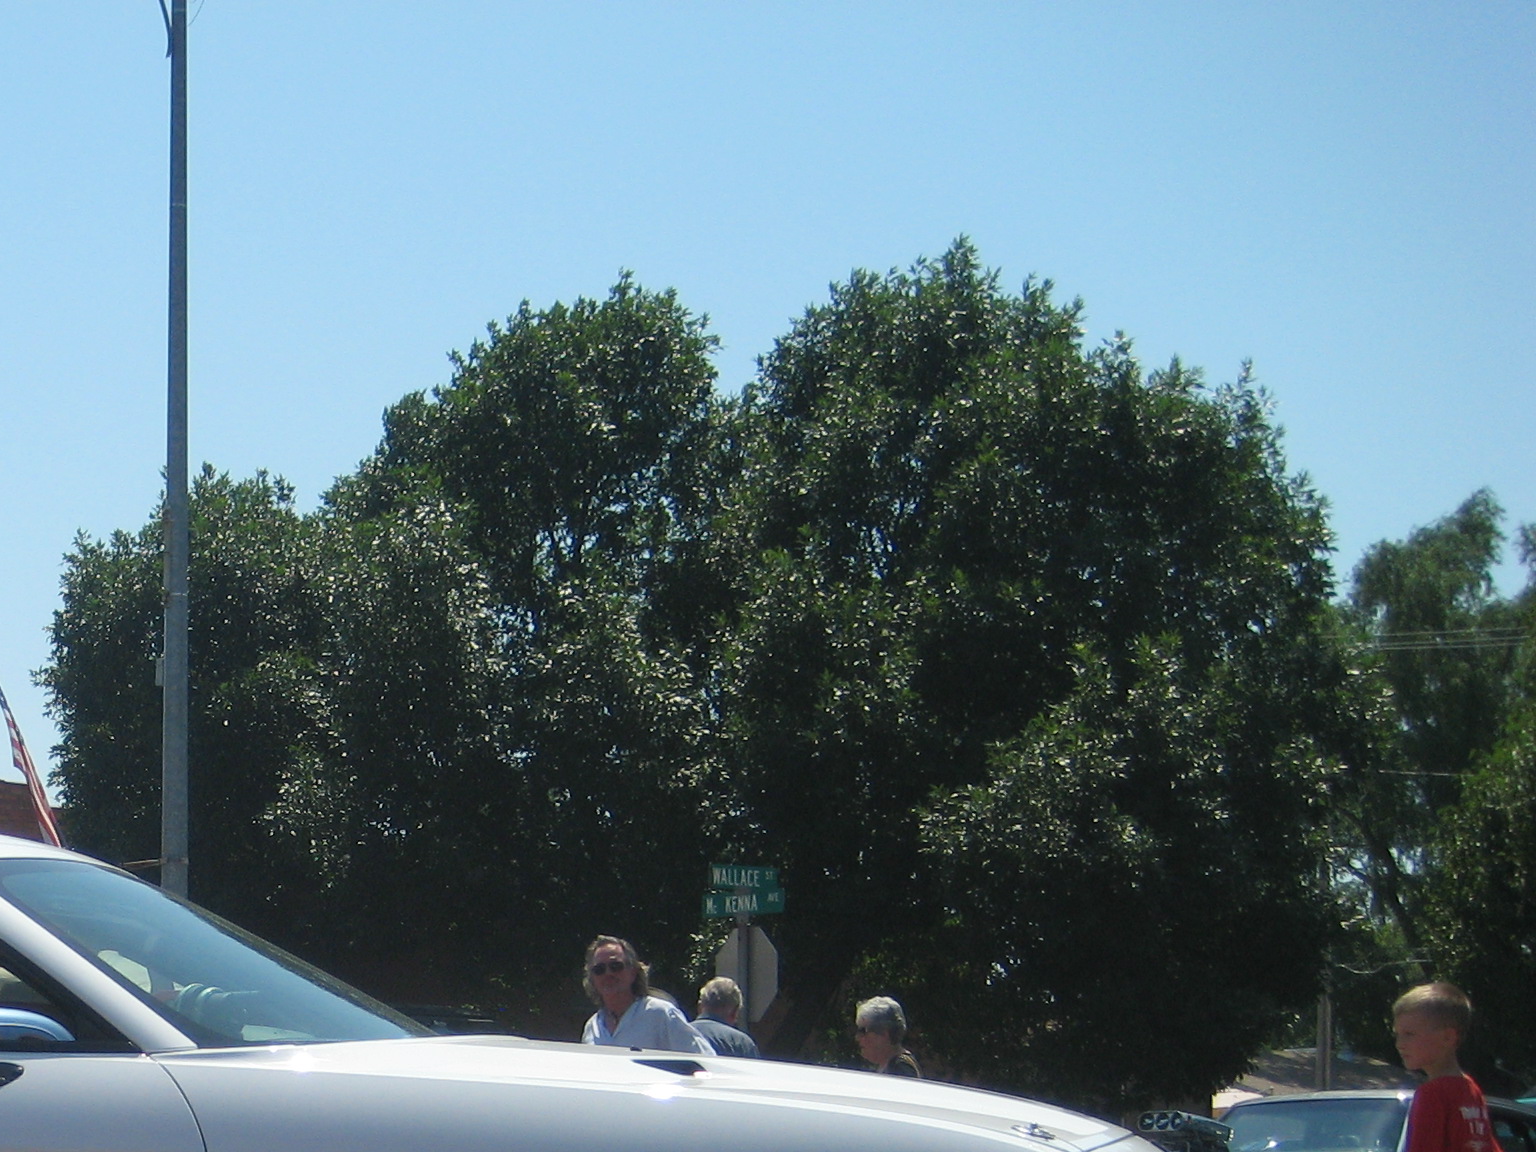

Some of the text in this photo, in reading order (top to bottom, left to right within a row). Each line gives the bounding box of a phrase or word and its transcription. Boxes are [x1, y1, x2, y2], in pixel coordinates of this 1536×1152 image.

[712, 867, 773, 887] WALLACE ST
[725, 894, 758, 913] KENNA
[767, 892, 779, 902] AVE
